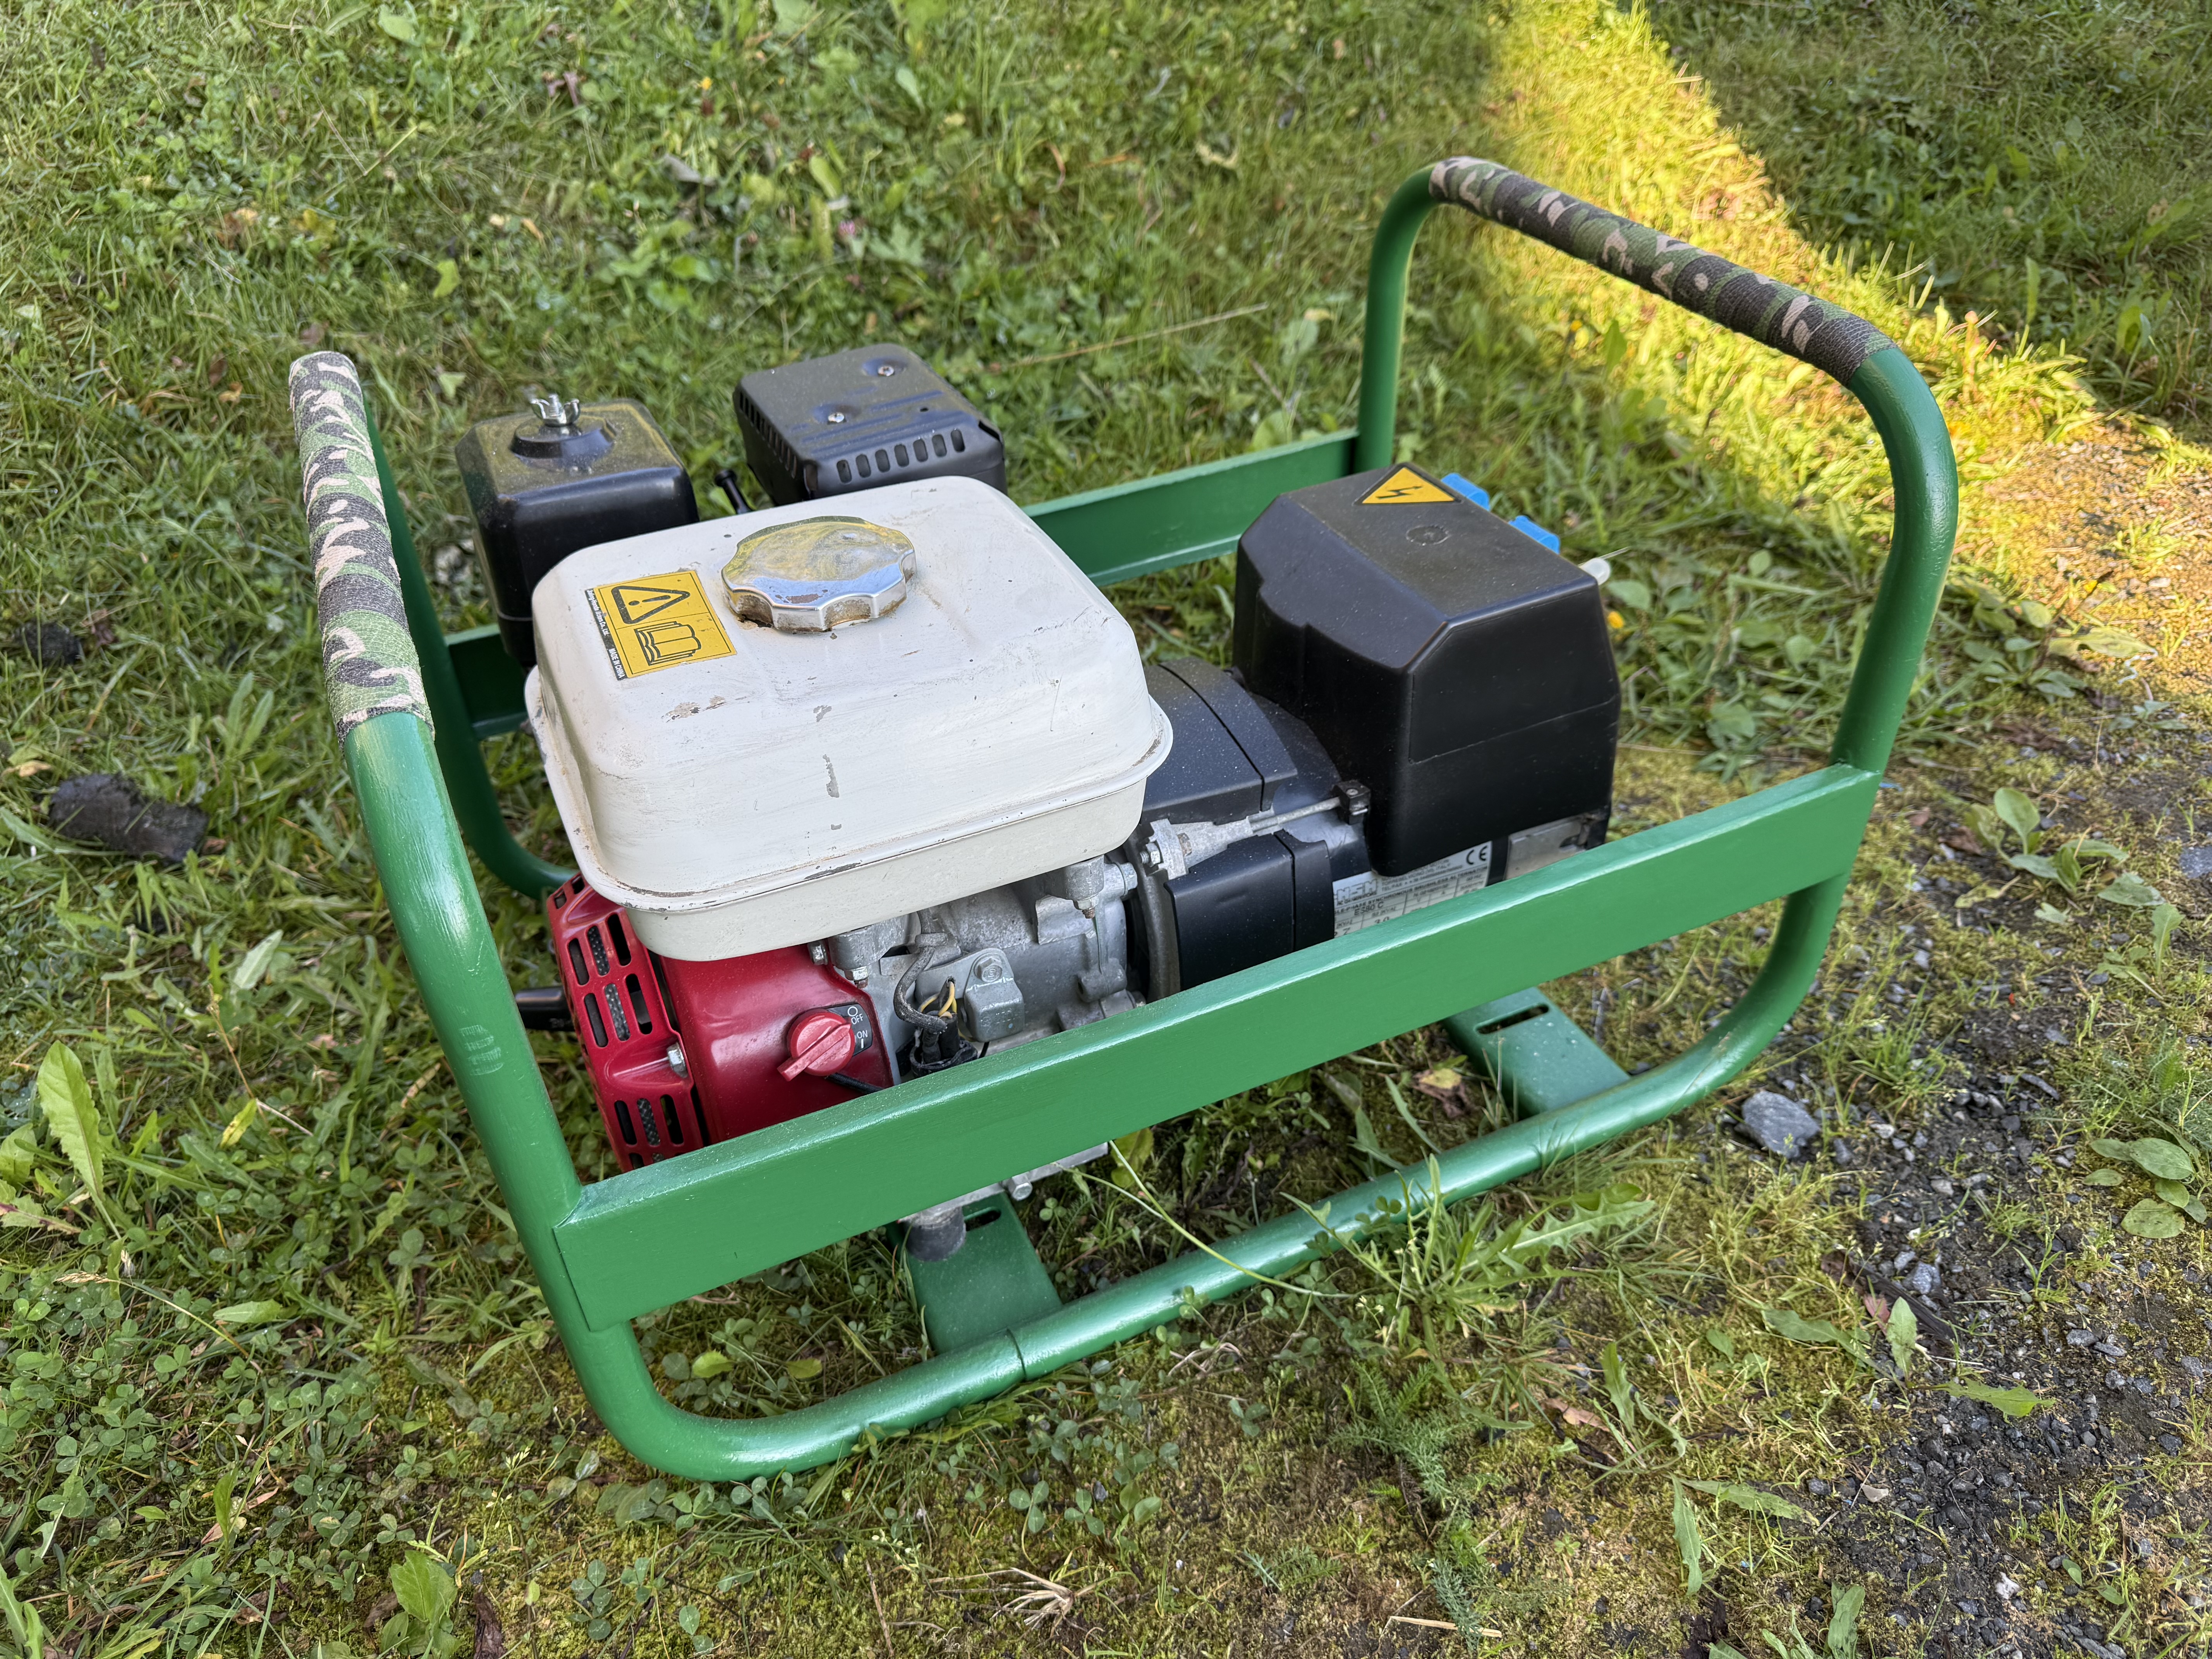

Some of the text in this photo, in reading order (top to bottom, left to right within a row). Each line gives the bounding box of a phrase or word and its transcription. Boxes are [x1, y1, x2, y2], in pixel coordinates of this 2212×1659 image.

[609, 648, 619, 661] MADE
[615, 665, 625, 678] CHINA
[851, 1013, 863, 1024] OFF
[857, 1030, 868, 1039] ON
